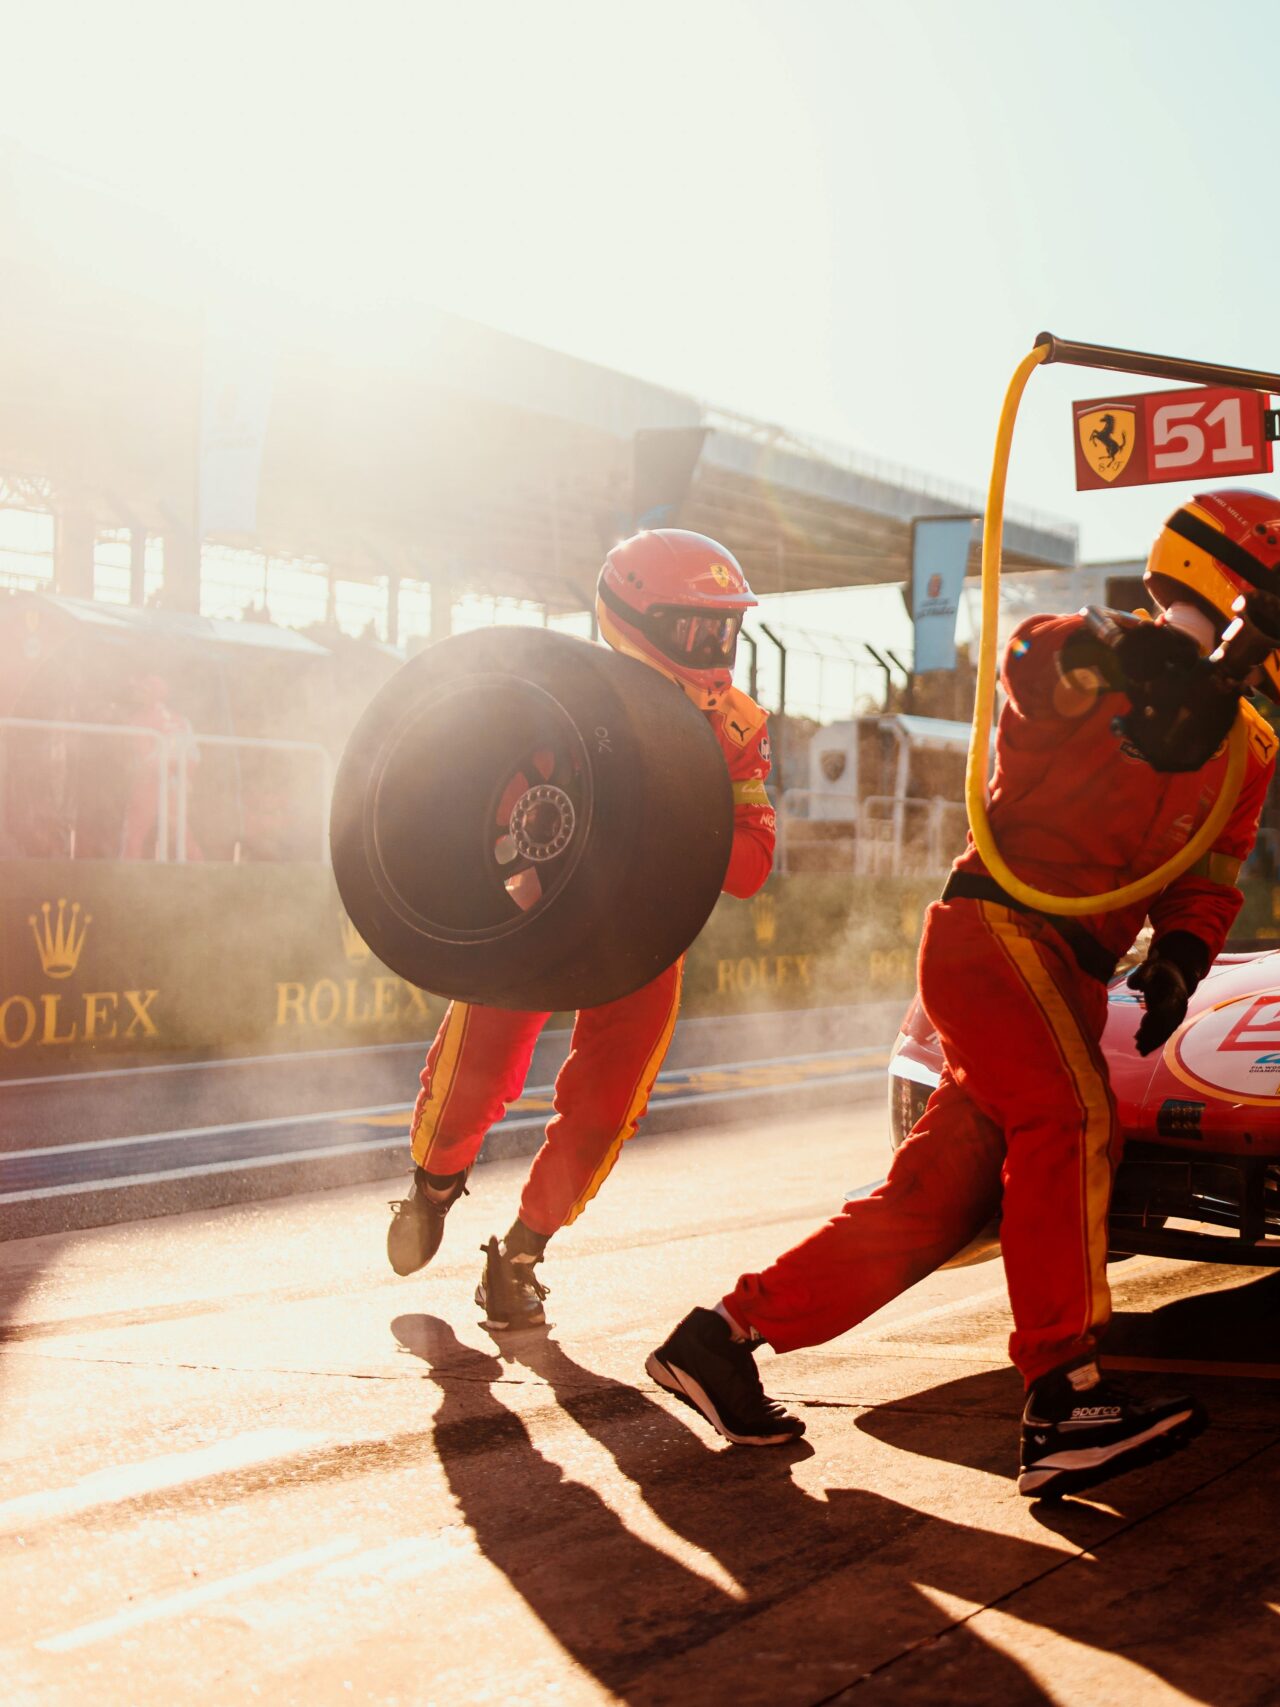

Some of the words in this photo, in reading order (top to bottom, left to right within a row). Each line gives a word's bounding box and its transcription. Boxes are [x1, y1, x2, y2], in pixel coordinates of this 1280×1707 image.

[1153, 398, 1254, 469] 51
[716, 954, 812, 993] ROLEX
[0, 989, 160, 1049] OLEX
[276, 976, 431, 1028] ROLEX
[1072, 1405, 1121, 1418] sparco
